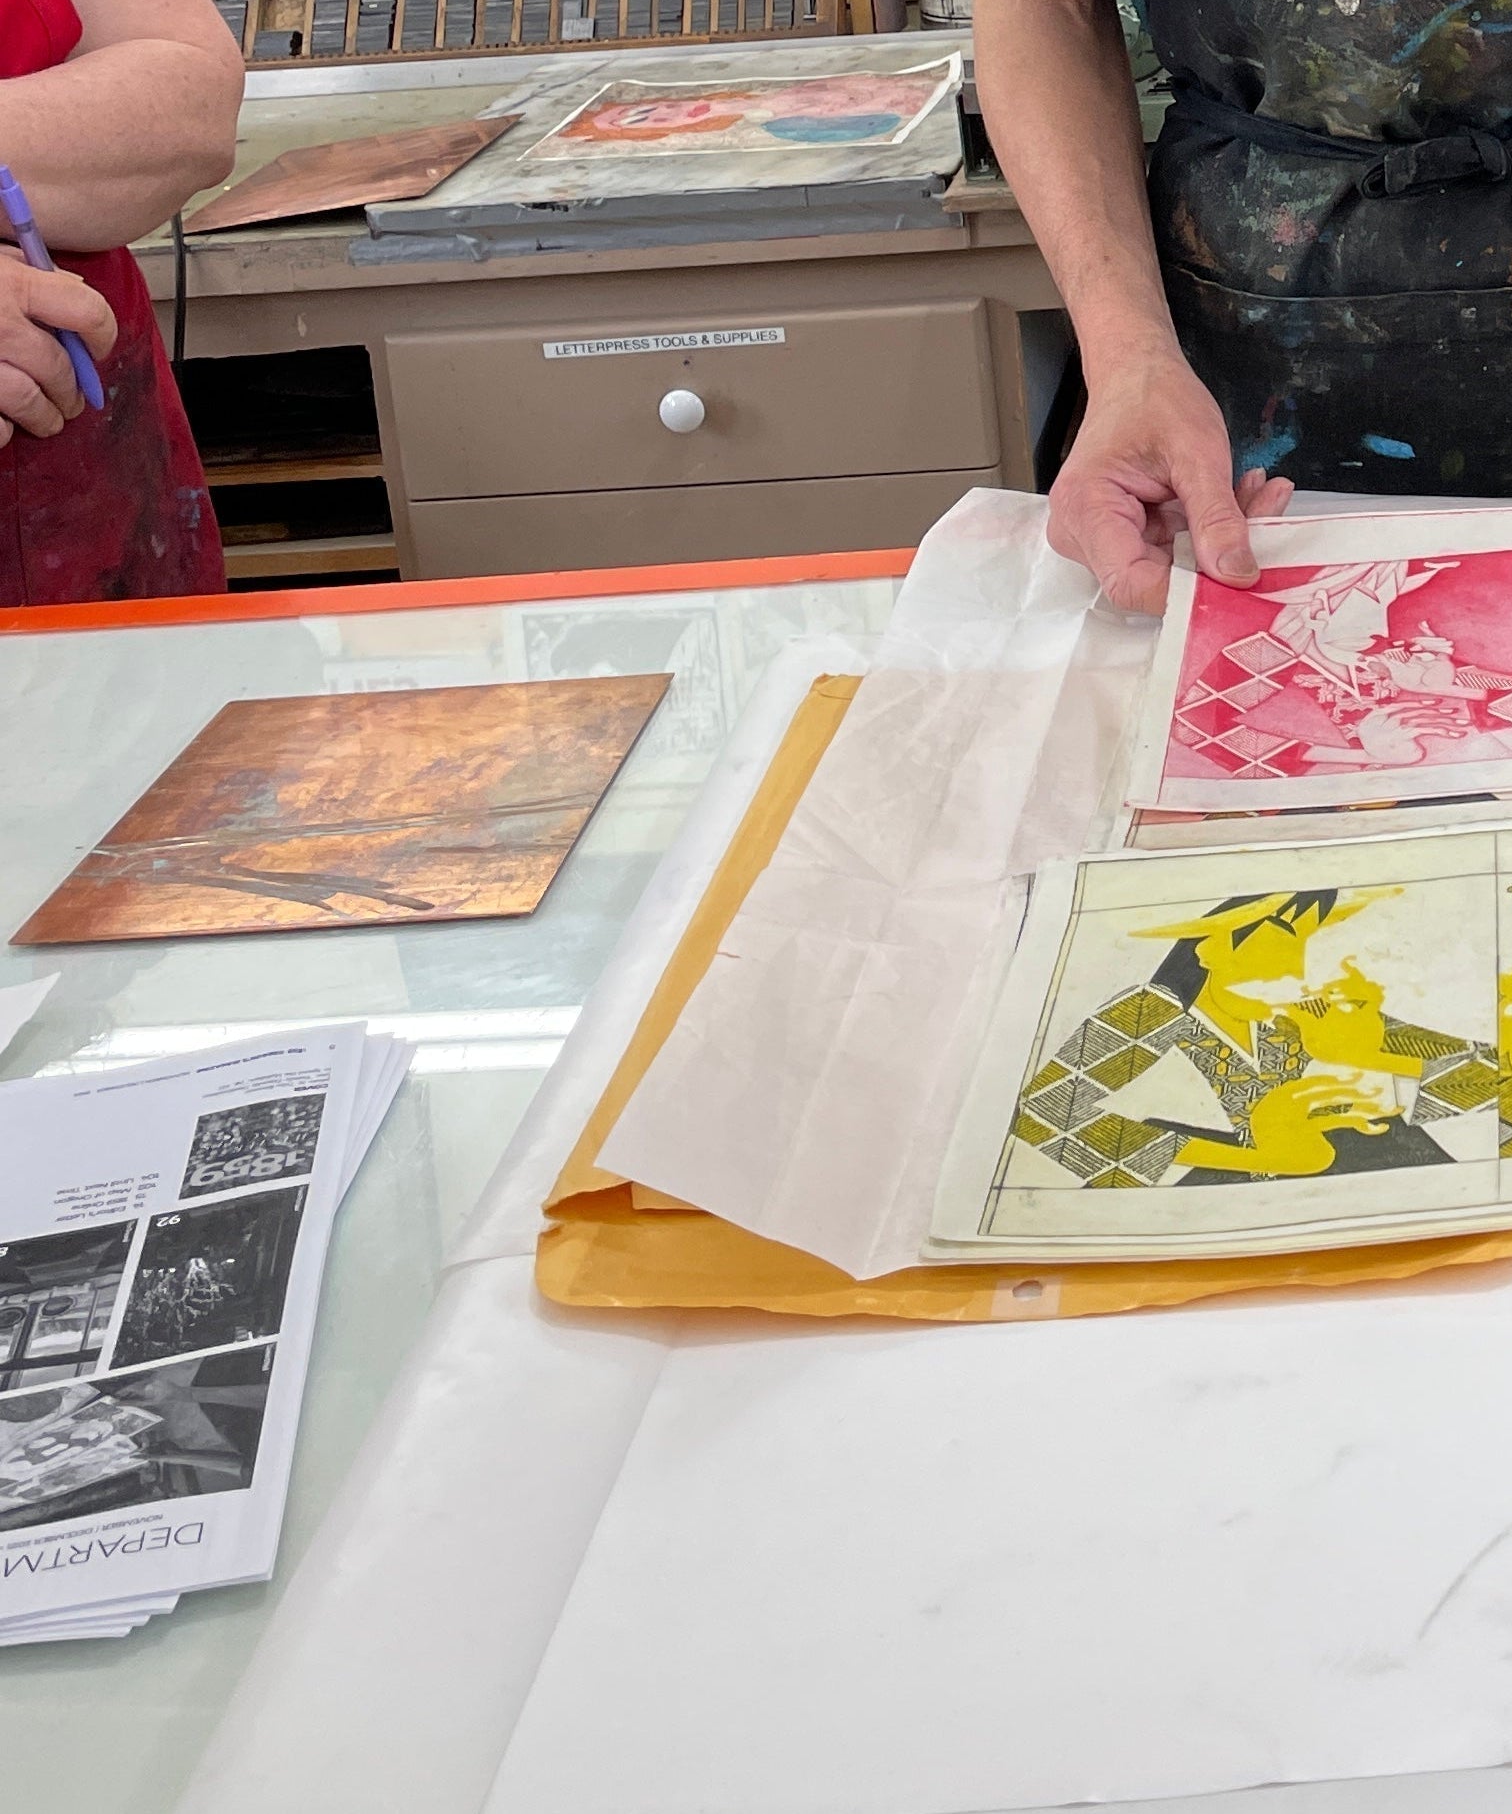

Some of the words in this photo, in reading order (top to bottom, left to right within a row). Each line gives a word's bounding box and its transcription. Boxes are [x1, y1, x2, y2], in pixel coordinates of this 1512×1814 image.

[554, 337, 650, 356] LETTERPRESS
[653, 334, 698, 349] TOOLS
[701, 333, 710, 345] &
[713, 329, 778, 345] SUPPLIES
[190, 1149, 306, 1187] 1859
[156, 1214, 181, 1227] 92
[102, 1513, 164, 1531] NOVEMBER
[34, 1527, 95, 1545] DECEMBER
[4, 1522, 204, 1578] DEPARTM
